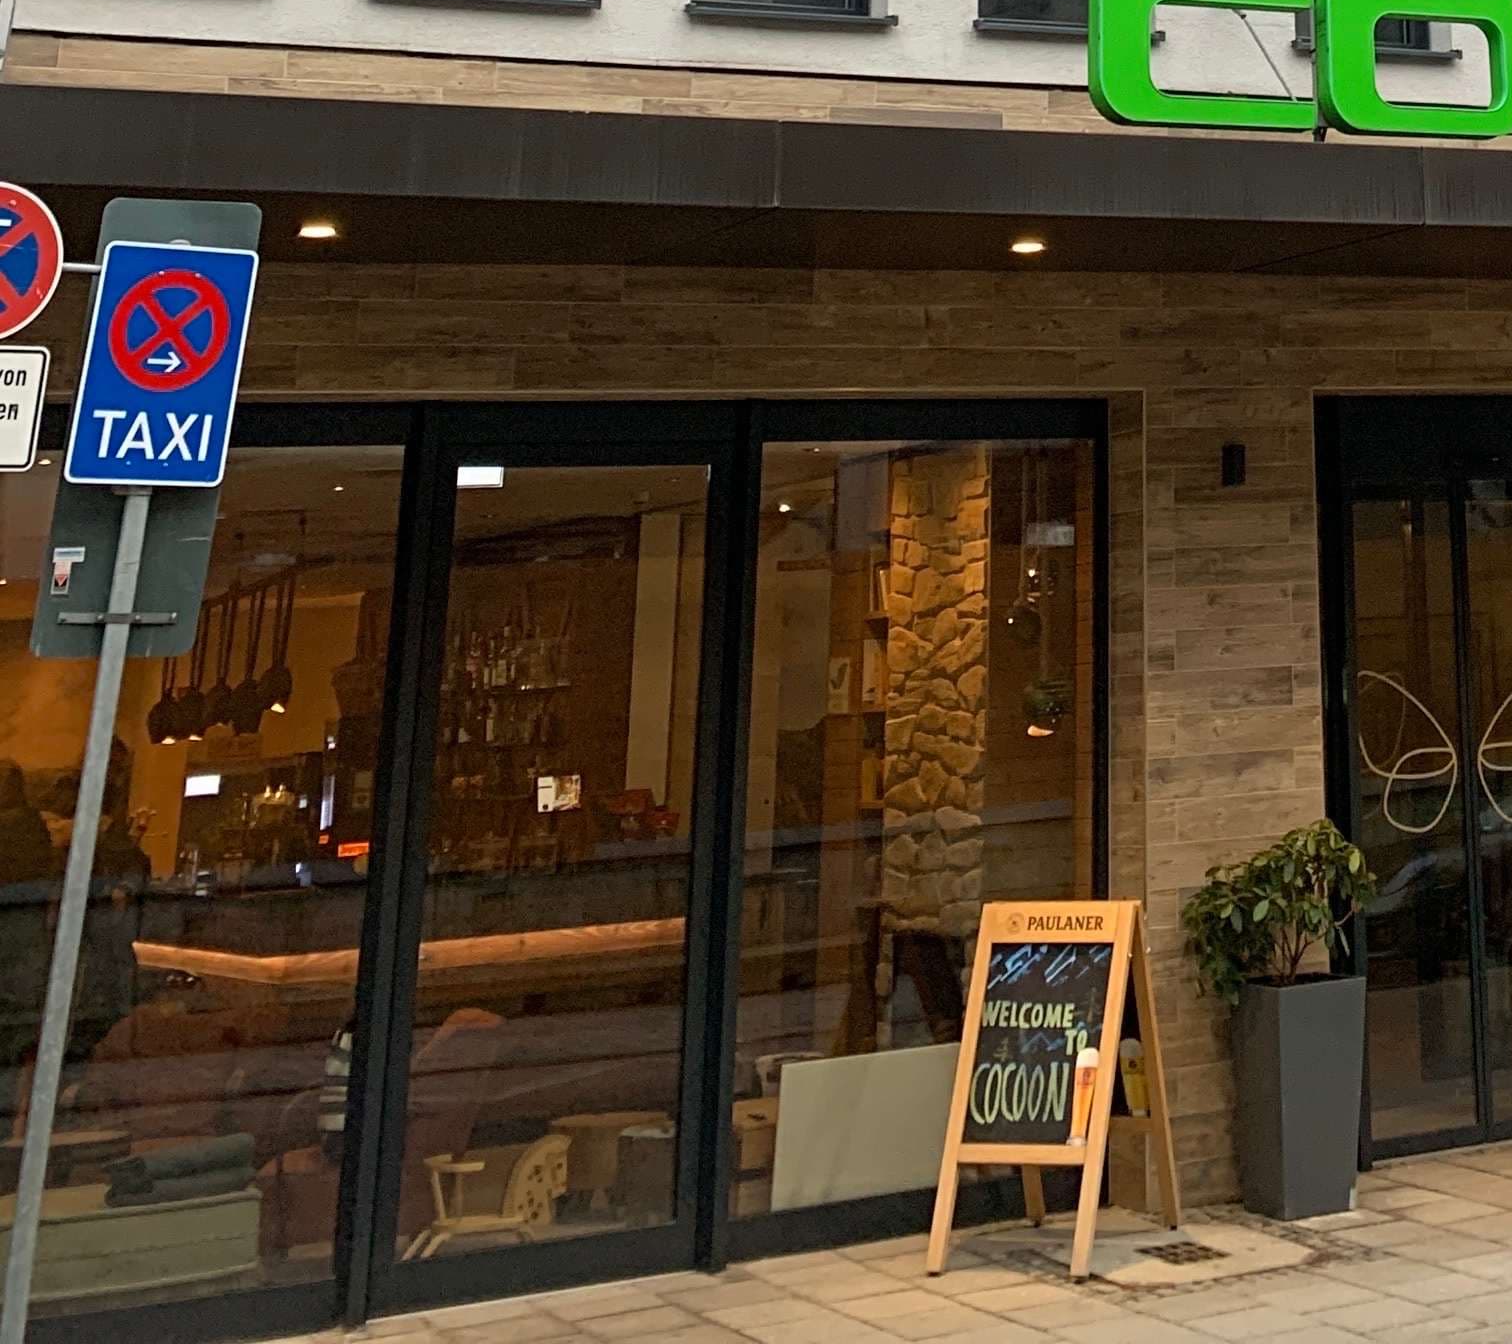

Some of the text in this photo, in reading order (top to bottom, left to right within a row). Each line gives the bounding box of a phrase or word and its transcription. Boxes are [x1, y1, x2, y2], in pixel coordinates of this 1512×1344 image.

[93, 409, 213, 462] TAXI
[1027, 916, 1104, 931] PAULANER
[982, 999, 1075, 1029] WELCOME
[1065, 1029, 1088, 1055] TO
[970, 1062, 1070, 1125] COCOON
